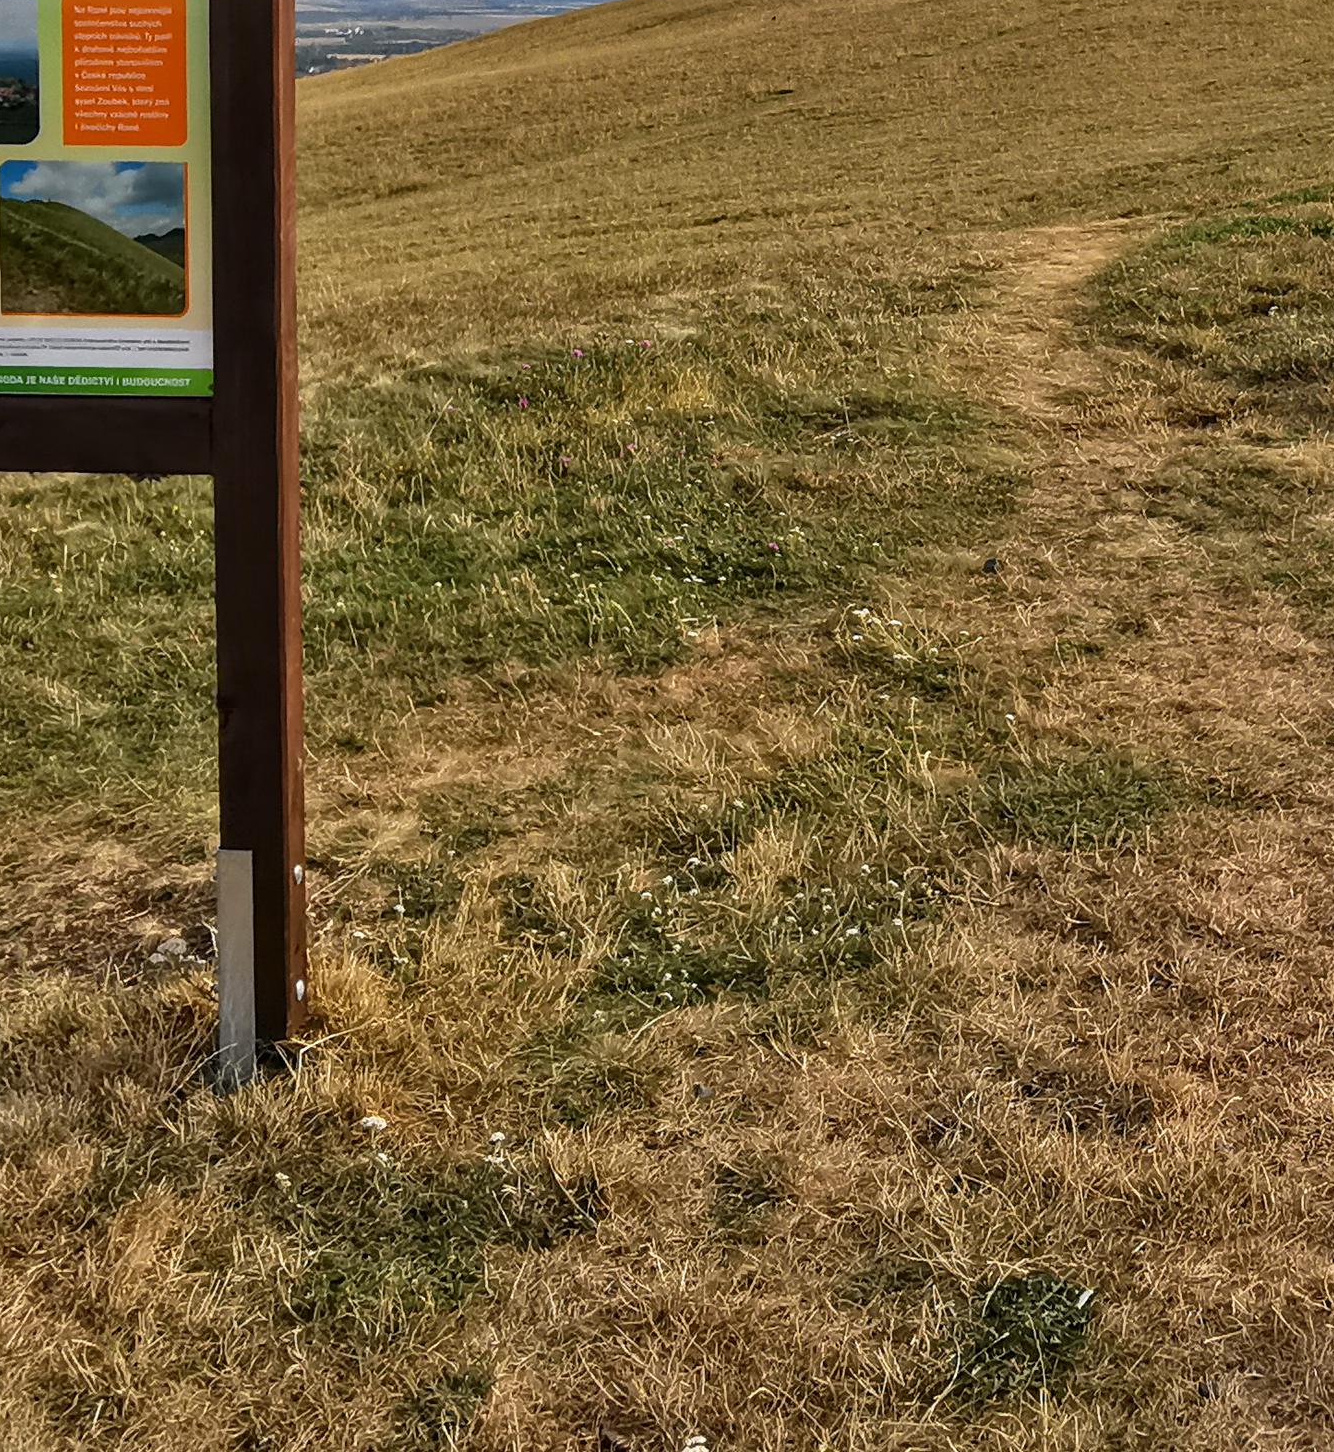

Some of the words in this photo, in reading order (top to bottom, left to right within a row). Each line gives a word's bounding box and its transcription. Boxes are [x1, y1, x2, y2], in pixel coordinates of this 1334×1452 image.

[25, 374, 37, 386] JE
[39, 373, 66, 386] NAŠE
[68, 373, 114, 387] DĚDICTVÍ
[122, 376, 191, 388] BUDOUCNOST
